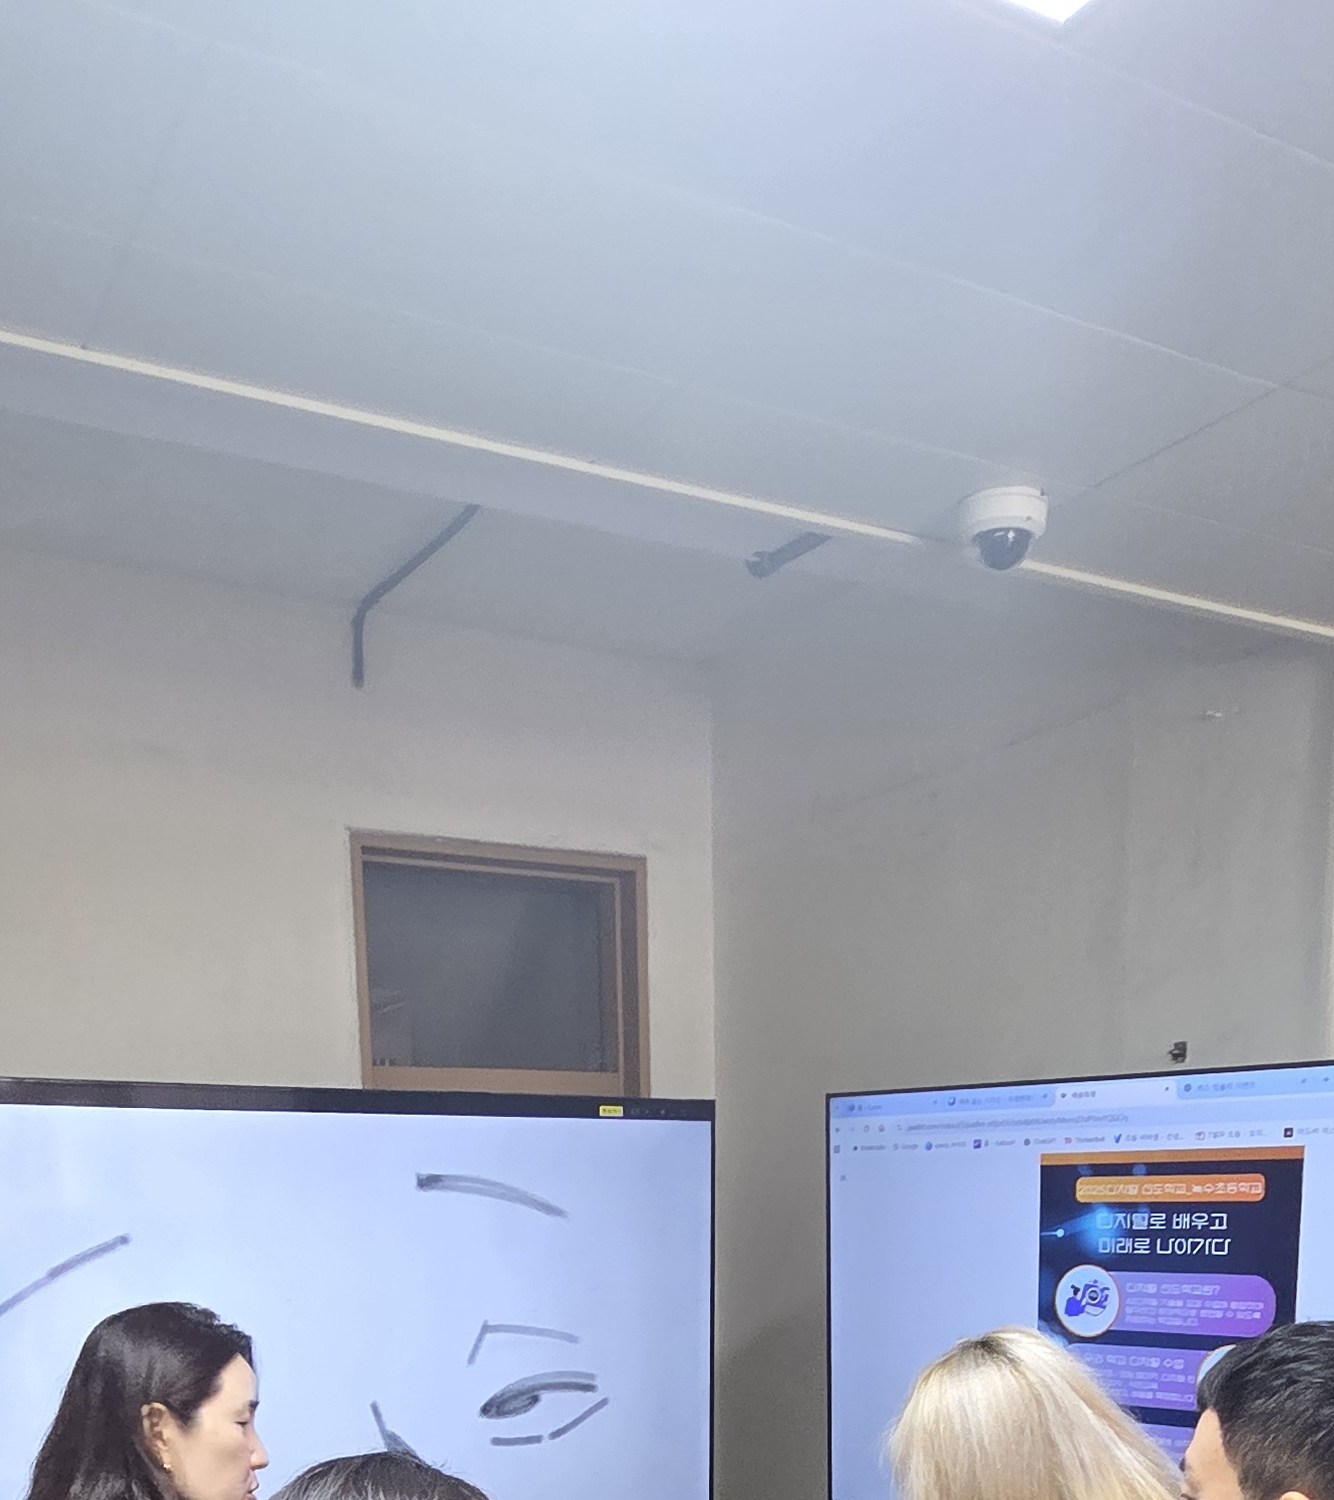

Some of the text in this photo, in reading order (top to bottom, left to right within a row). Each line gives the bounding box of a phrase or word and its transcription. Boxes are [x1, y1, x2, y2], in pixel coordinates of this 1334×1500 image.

[1095, 1212, 1228, 1230] 디지털로 배우고
[1098, 1237, 1152, 1254] 미래로
